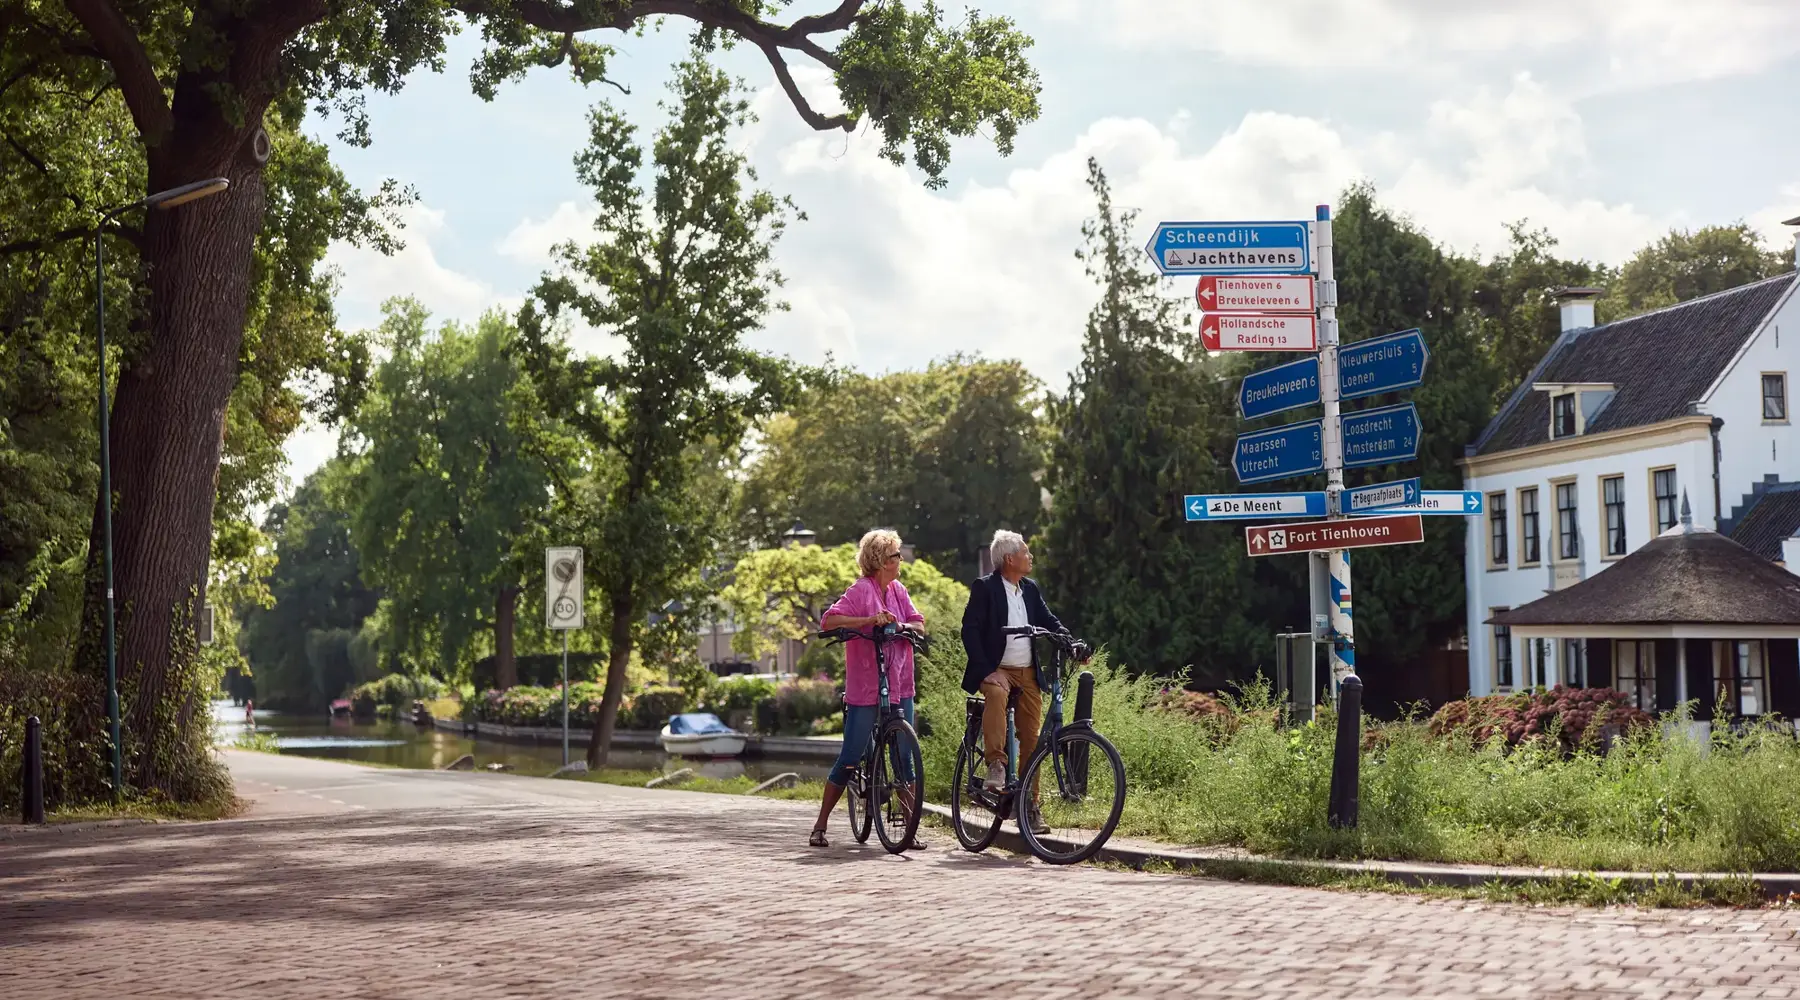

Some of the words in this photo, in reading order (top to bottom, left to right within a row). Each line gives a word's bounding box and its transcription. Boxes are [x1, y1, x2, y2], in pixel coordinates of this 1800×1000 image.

[1166, 229, 1260, 247] Scheendijk
[1295, 232, 1300, 242] 1
[1187, 251, 1296, 265] Jachthavens
[1217, 280, 1273, 290] Tienhoven
[1276, 282, 1282, 290] 6
[1218, 295, 1291, 305] Breukeleveen
[1294, 297, 1300, 305] 6
[1220, 319, 1286, 329] Hollandsche
[1237, 334, 1275, 347] Rading
[1277, 336, 1287, 344] 13
[1340, 344, 1403, 369] Nieuwersluis
[1410, 342, 1417, 354] 3
[1341, 371, 1375, 388] Loenen
[1411, 362, 1418, 374] 5
[1246, 377, 1308, 404] Breukeleveen
[1309, 375, 1316, 387] 6
[1344, 416, 1393, 436] Loosdrecht
[1406, 415, 1412, 427] 9
[1241, 437, 1287, 455] Maarssen
[1313, 431, 1319, 442] 5
[1345, 437, 1396, 456] Amsterdam
[1403, 436, 1413, 448] 24
[1241, 455, 1279, 473] Utrecht
[1311, 450, 1320, 461] 12
[1359, 488, 1402, 505] Begraafplaats
[1223, 502, 1240, 512] De
[1243, 500, 1282, 512] Meent
[1289, 529, 1317, 543] Fort
[1320, 524, 1390, 541] Tienhoven
